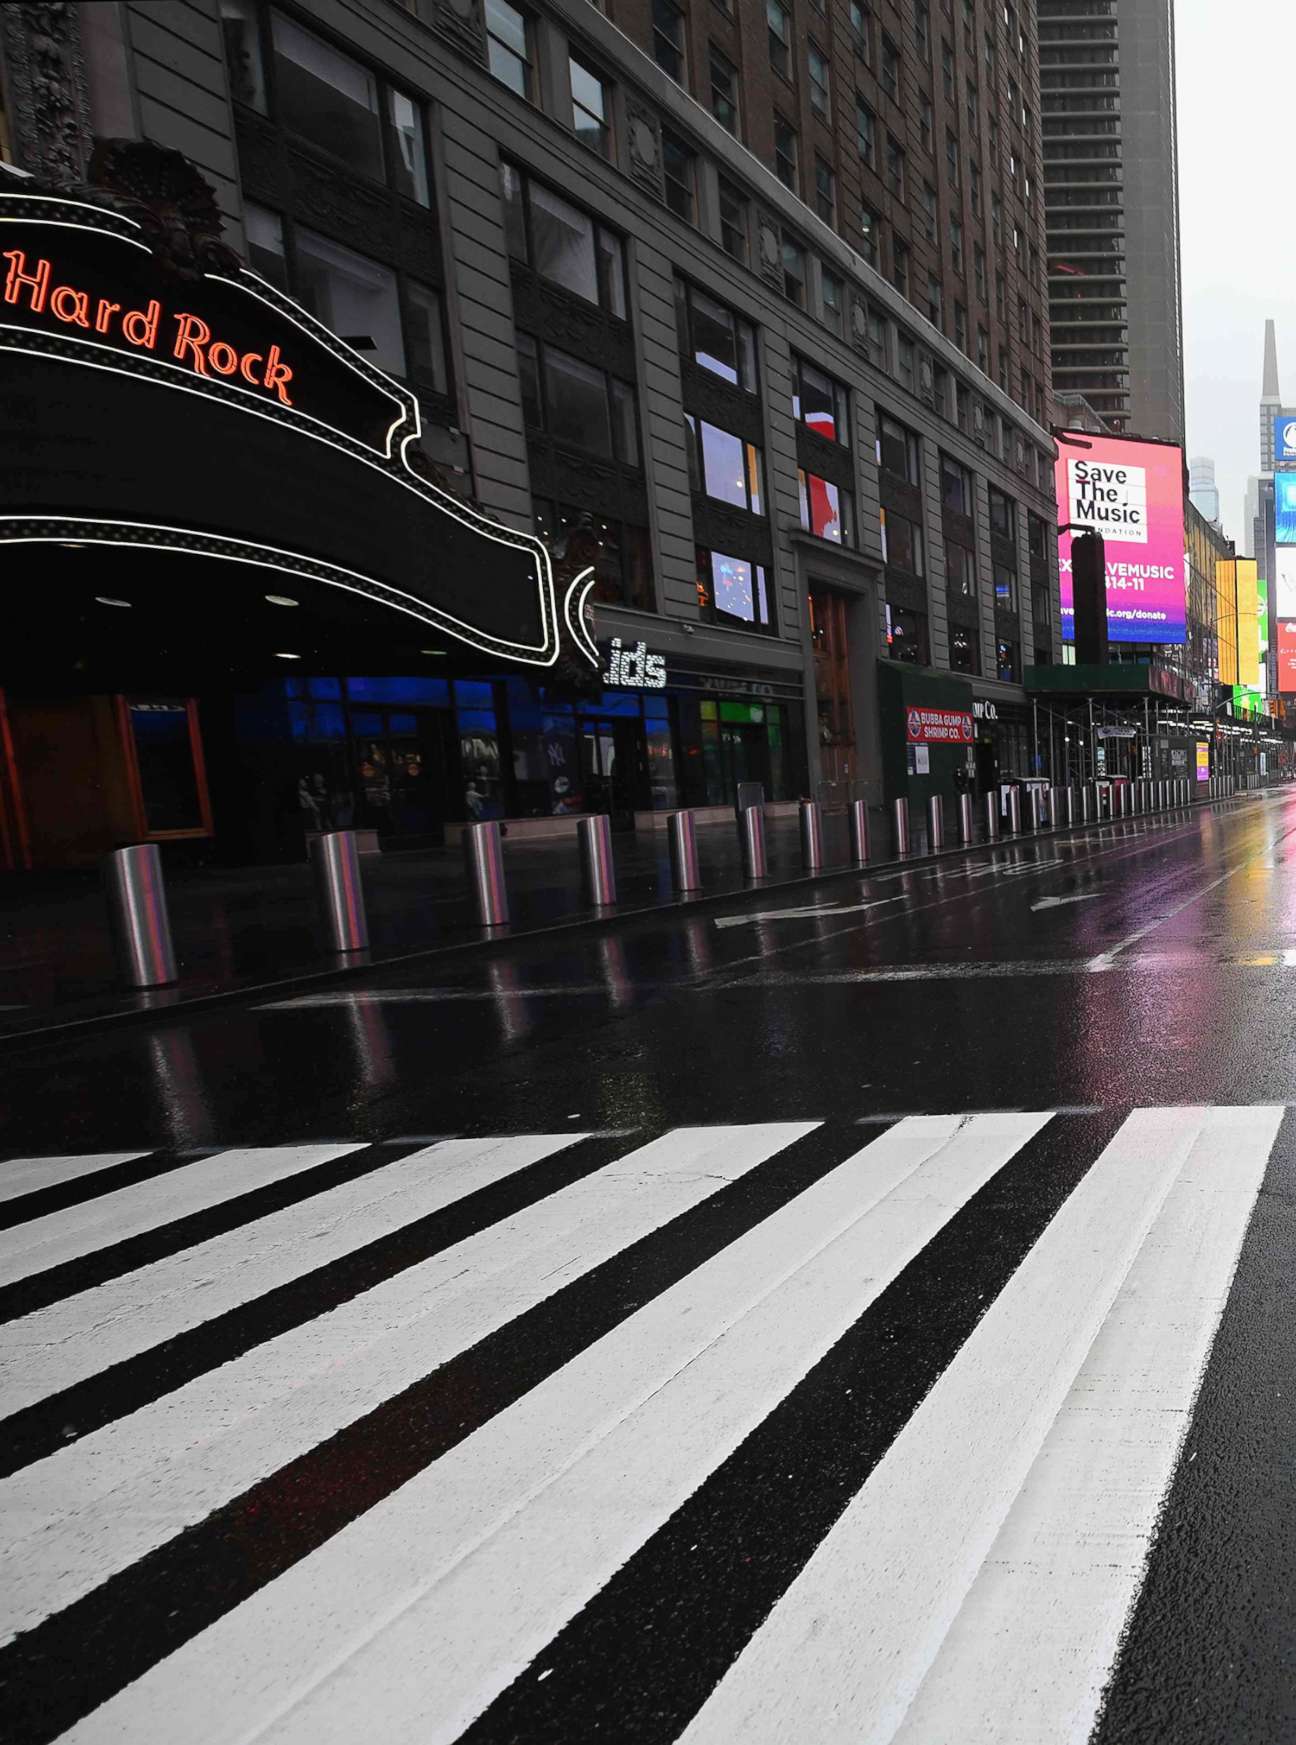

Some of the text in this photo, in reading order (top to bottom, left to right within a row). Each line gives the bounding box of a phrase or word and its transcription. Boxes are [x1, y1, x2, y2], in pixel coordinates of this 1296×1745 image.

[3, 250, 294, 405] Hard Rock
[1075, 460, 1127, 484] Save
[1076, 480, 1118, 502] The
[1077, 499, 1140, 524] Music
[1105, 562, 1175, 579] VEMUSIC
[603, 637, 668, 688] ids
[921, 712, 962, 727] BUBBA GUMP
[924, 726, 949, 738] SHRIMP
